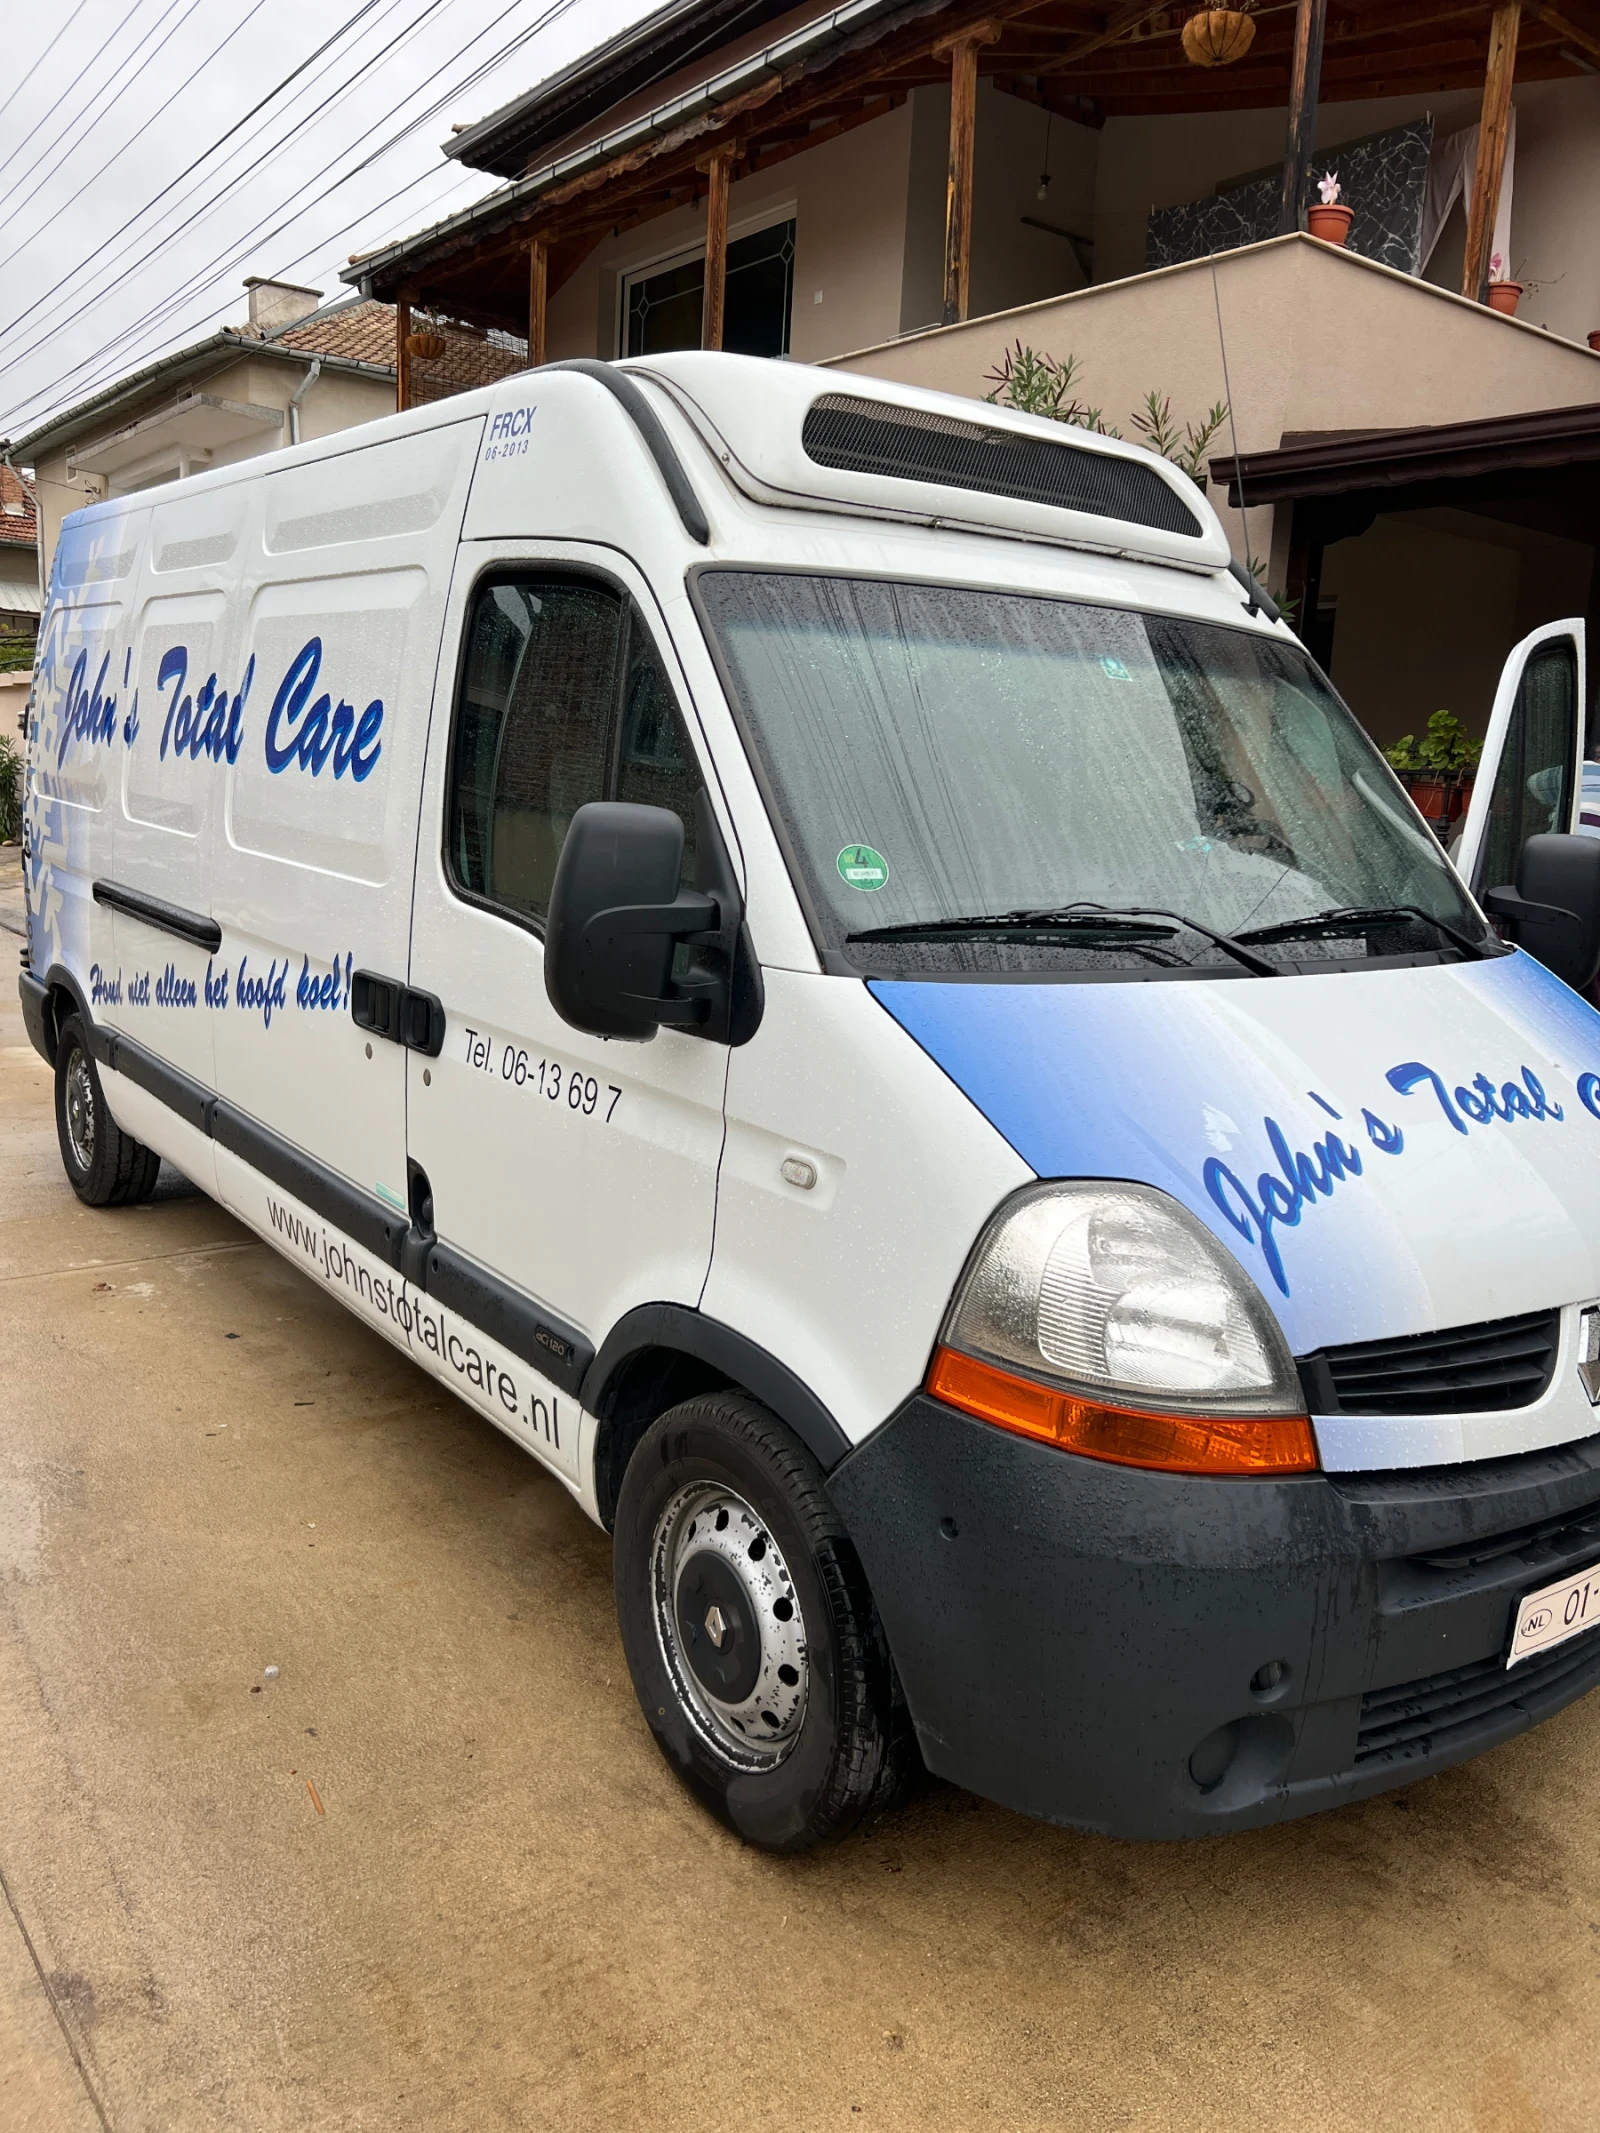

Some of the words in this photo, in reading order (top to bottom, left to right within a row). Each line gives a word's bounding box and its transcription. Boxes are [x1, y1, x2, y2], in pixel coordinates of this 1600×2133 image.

[485, 439, 529, 461] 06-2013
[489, 405, 538, 441] FRCX
[57, 646, 140, 771] John's
[157, 645, 256, 765] Total
[264, 636, 385, 782] Care
[855, 848, 868, 868] 4
[90, 963, 122, 1006] Houd
[128, 971, 150, 1007] niet
[155, 962, 198, 1009] alleen
[205, 958, 228, 1009] het
[236, 955, 288, 1030] hoofd
[296, 950, 353, 1011] koel!
[465, 1028, 493, 1073] Tel.
[502, 1045, 562, 1100] 06-13
[568, 1071, 598, 1115] 69
[606, 1084, 622, 1123] 7
[1202, 1090, 1404, 1299] John's
[1384, 1061, 1565, 1136] Total
[267, 1196, 560, 1450] www.johnstotalcare.nl
[1526, 1615, 1546, 1632] NL
